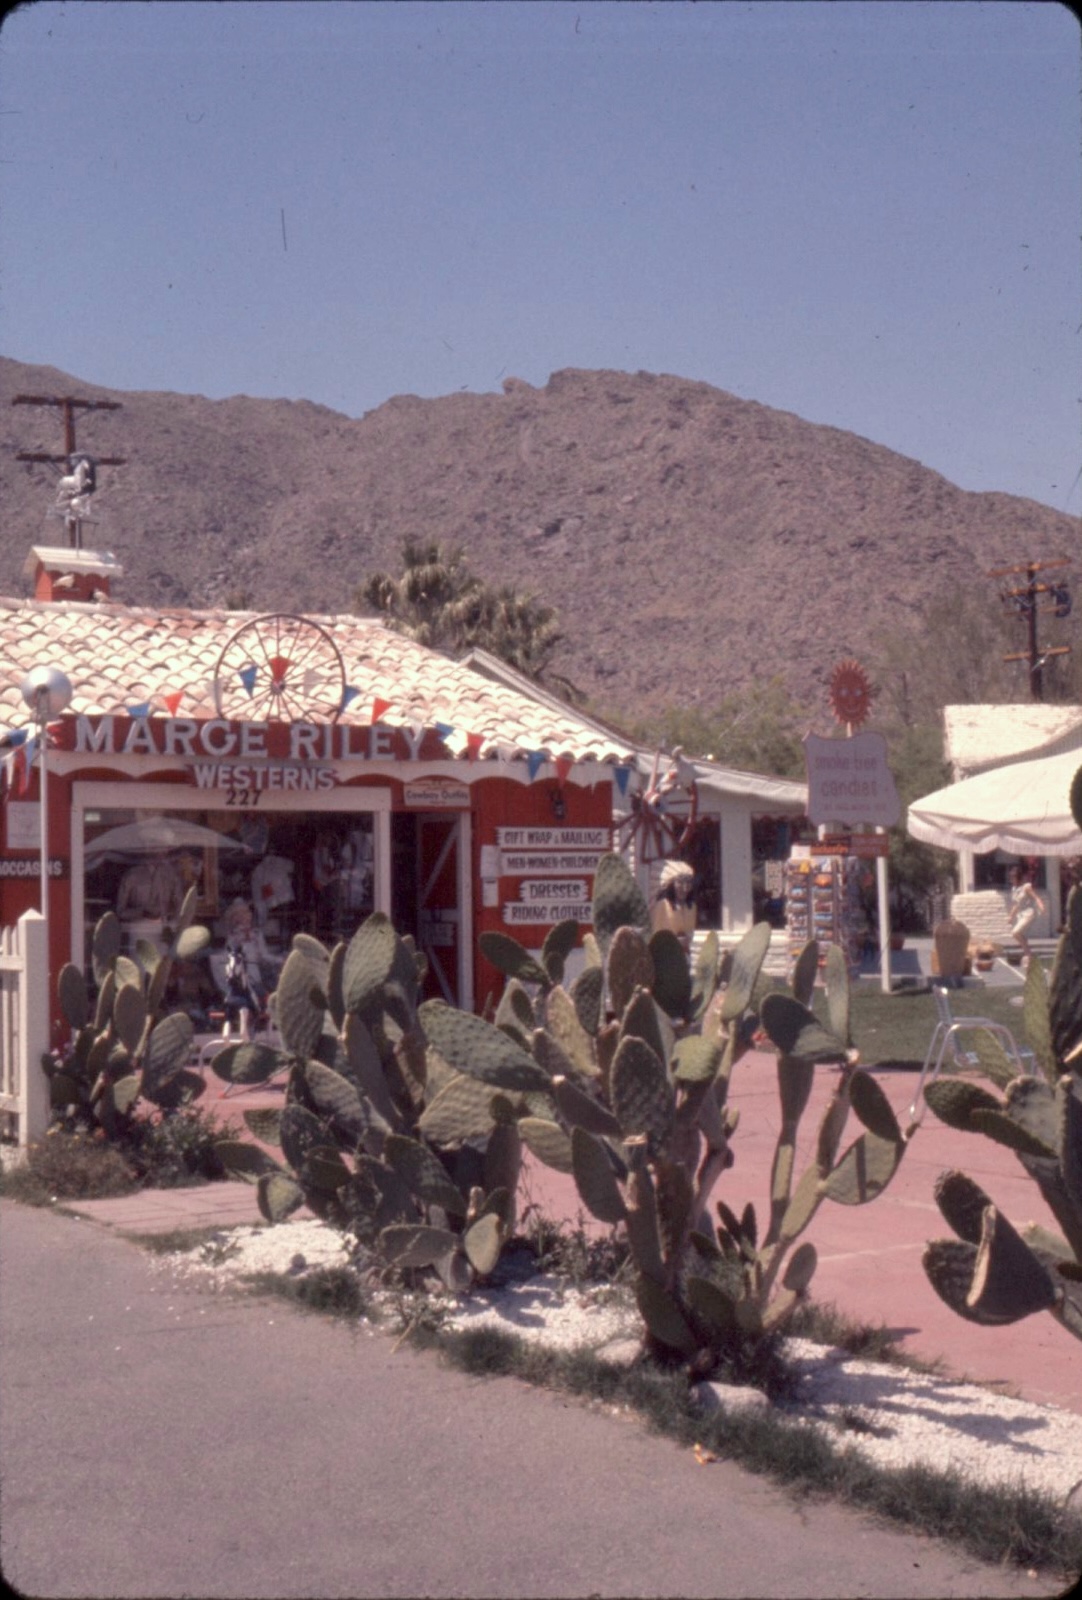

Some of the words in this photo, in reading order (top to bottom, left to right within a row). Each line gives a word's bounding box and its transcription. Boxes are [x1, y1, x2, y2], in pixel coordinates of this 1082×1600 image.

[75, 715, 268, 757] MARGE
[291, 721, 427, 762] RILEY
[194, 764, 335, 791] WESTERNS
[225, 788, 262, 806] 227
[504, 831, 525, 845] GIFT
[527, 831, 553, 845] WRAP
[560, 831, 603, 845] MAILING
[0, 861, 63, 876] OCCASNS
[529, 883, 581, 899] DRESSES
[511, 905, 548, 921] RIDING
[549, 905, 592, 921] CLOTHES
